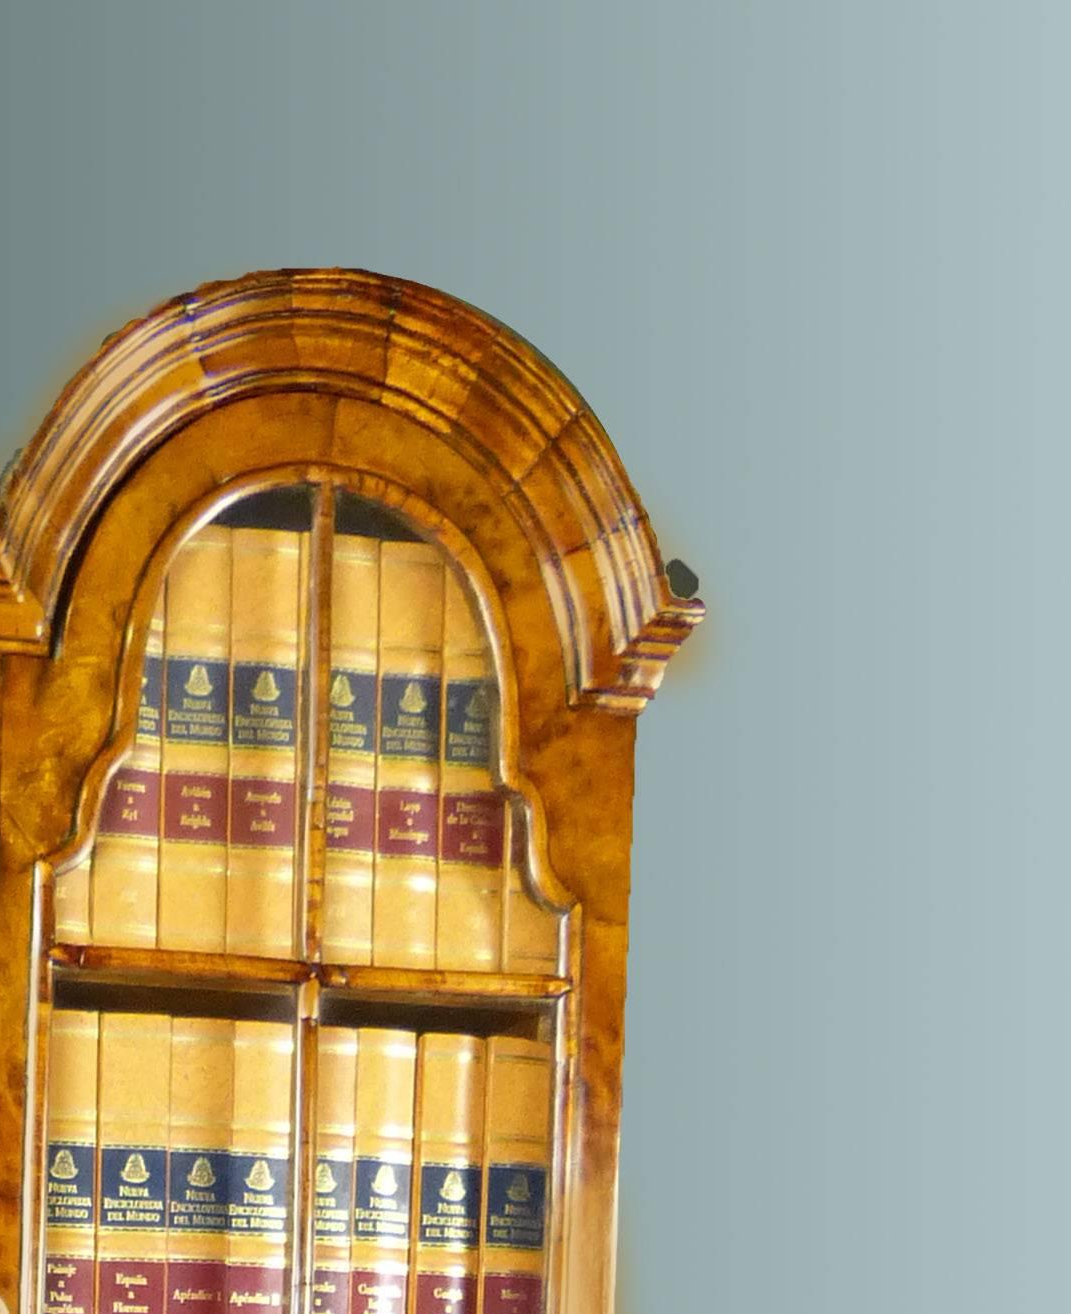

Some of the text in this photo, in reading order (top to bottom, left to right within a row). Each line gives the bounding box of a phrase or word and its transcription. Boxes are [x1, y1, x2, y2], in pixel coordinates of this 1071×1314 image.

[119, 1186, 149, 1197] NUEVA
[103, 1198, 163, 1211] ENCICLOPEDIA
[107, 1211, 161, 1223] DEL MUNDO
